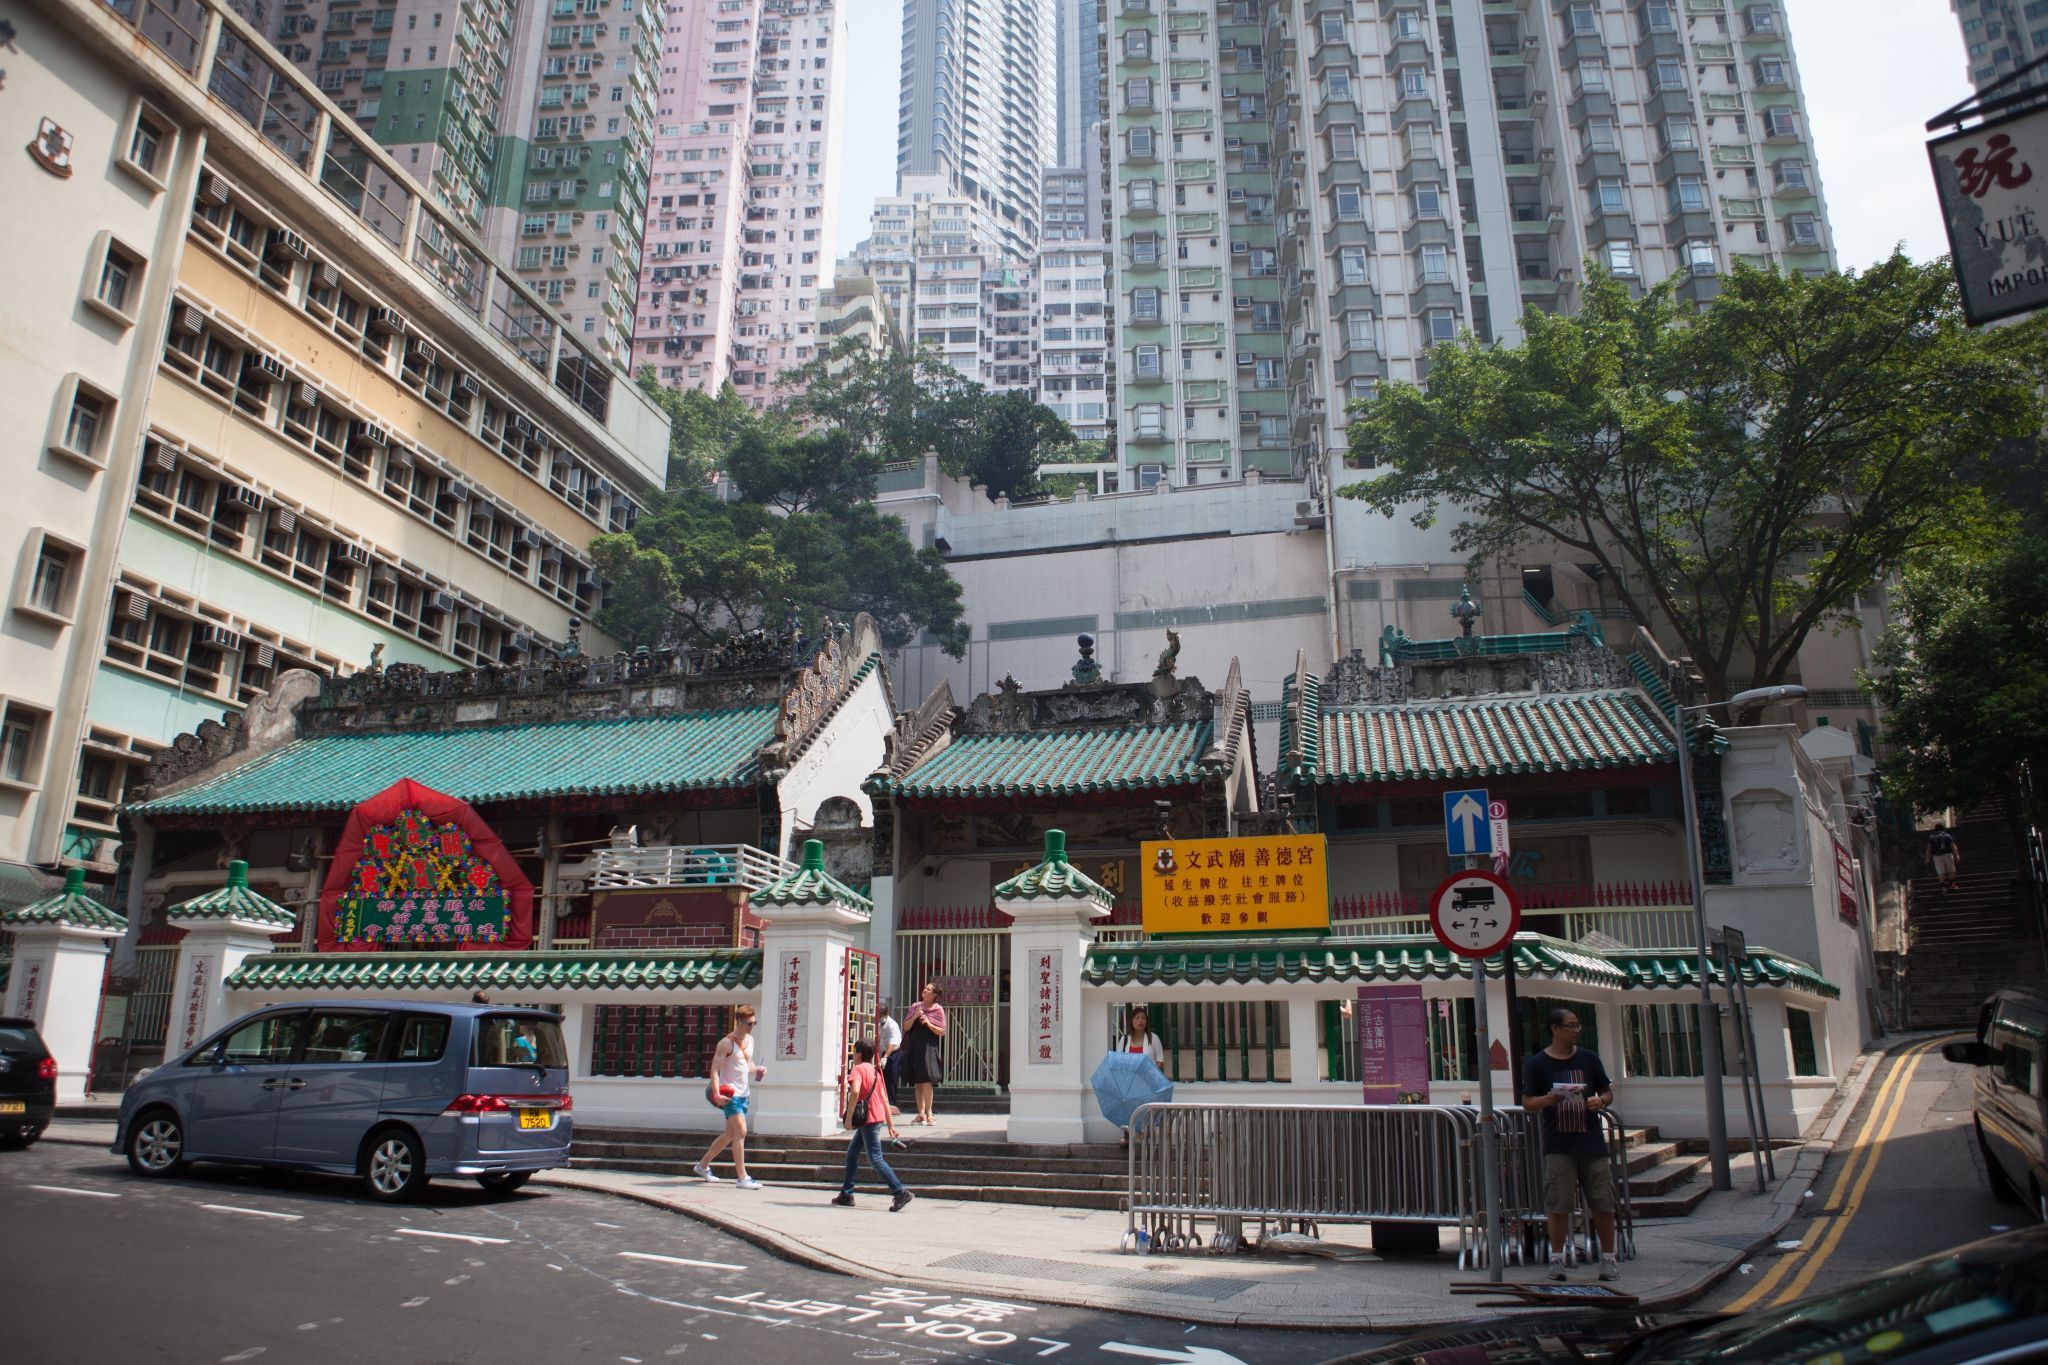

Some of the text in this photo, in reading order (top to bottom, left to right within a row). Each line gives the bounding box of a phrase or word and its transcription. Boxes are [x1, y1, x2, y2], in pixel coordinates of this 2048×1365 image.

[1954, 133, 2033, 198] 玩
[1494, 822, 1503, 853] Central
[1164, 874, 1304, 891] 延生牌位 往生牌位
[1201, 911, 1268, 925] 歡迎參觀
[1470, 918, 1478, 929] 7
[525, 1117, 546, 1128] 7520
[714, 1292, 1071, 1356] LOOK LEFT
